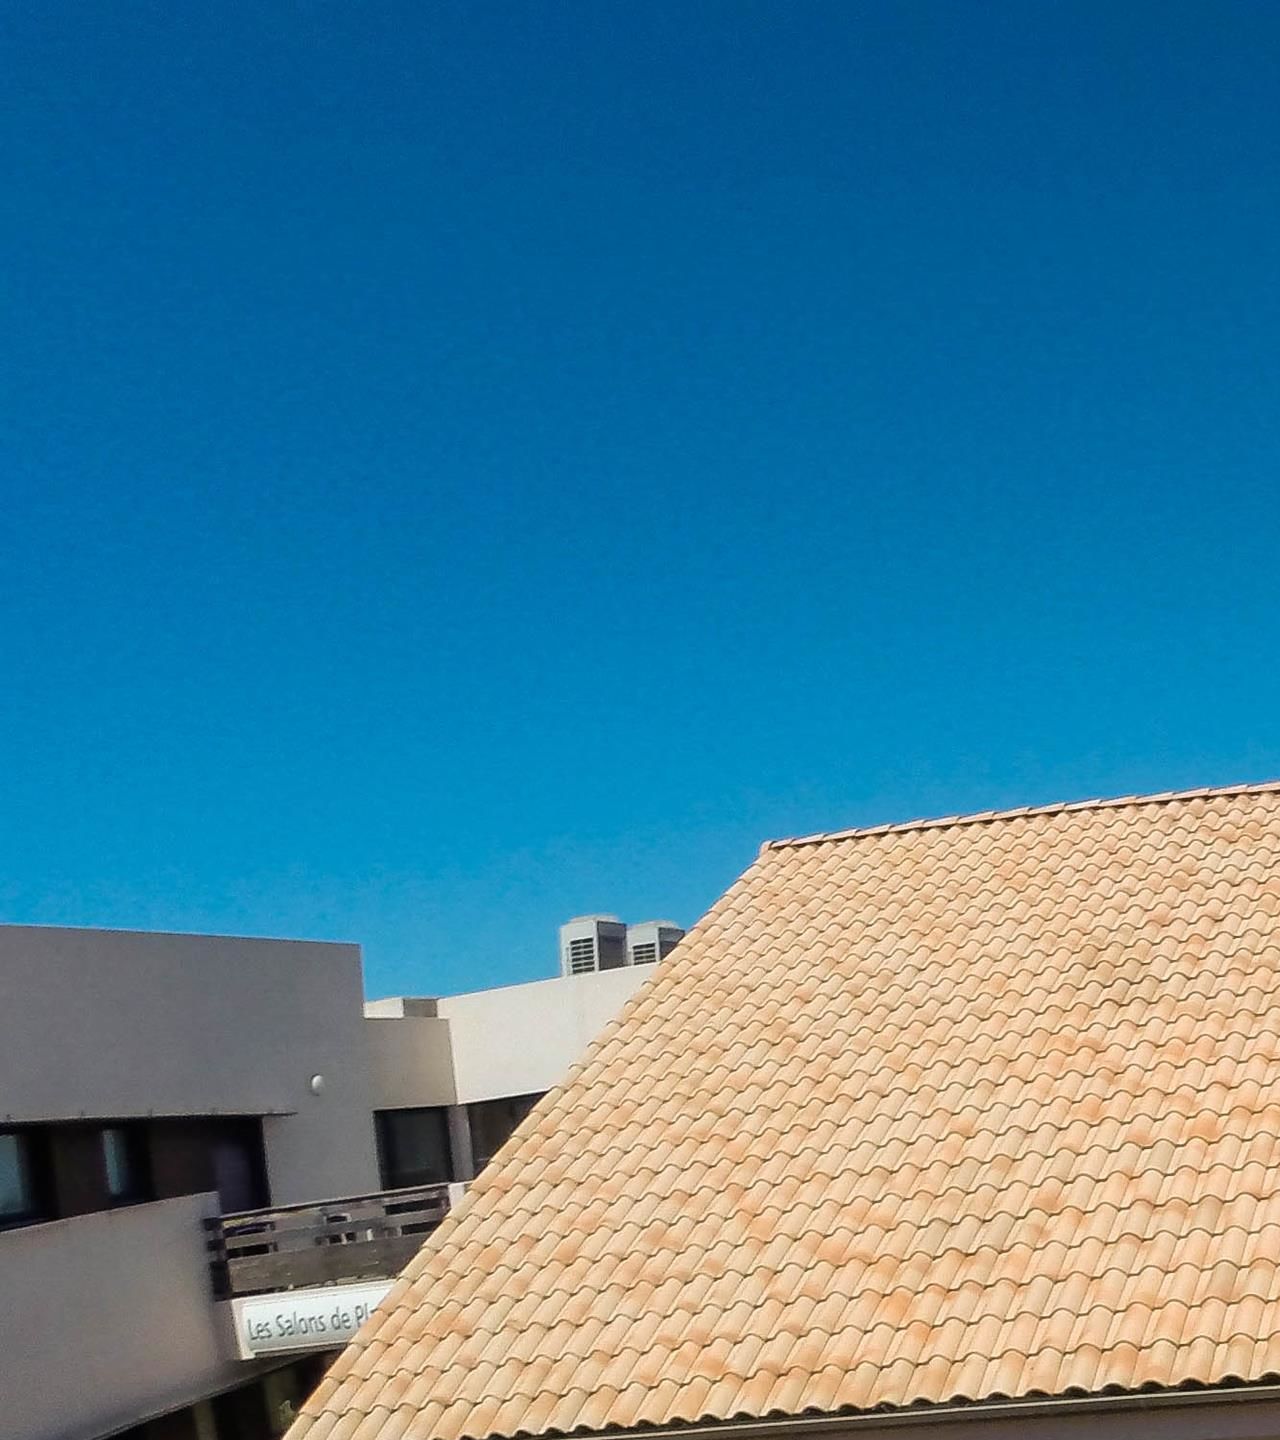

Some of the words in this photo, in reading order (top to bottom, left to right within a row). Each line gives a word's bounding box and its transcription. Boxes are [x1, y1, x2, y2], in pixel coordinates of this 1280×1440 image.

[247, 1318, 273, 1341] Les
[275, 1311, 326, 1338] Salons
[330, 1306, 351, 1330] de
